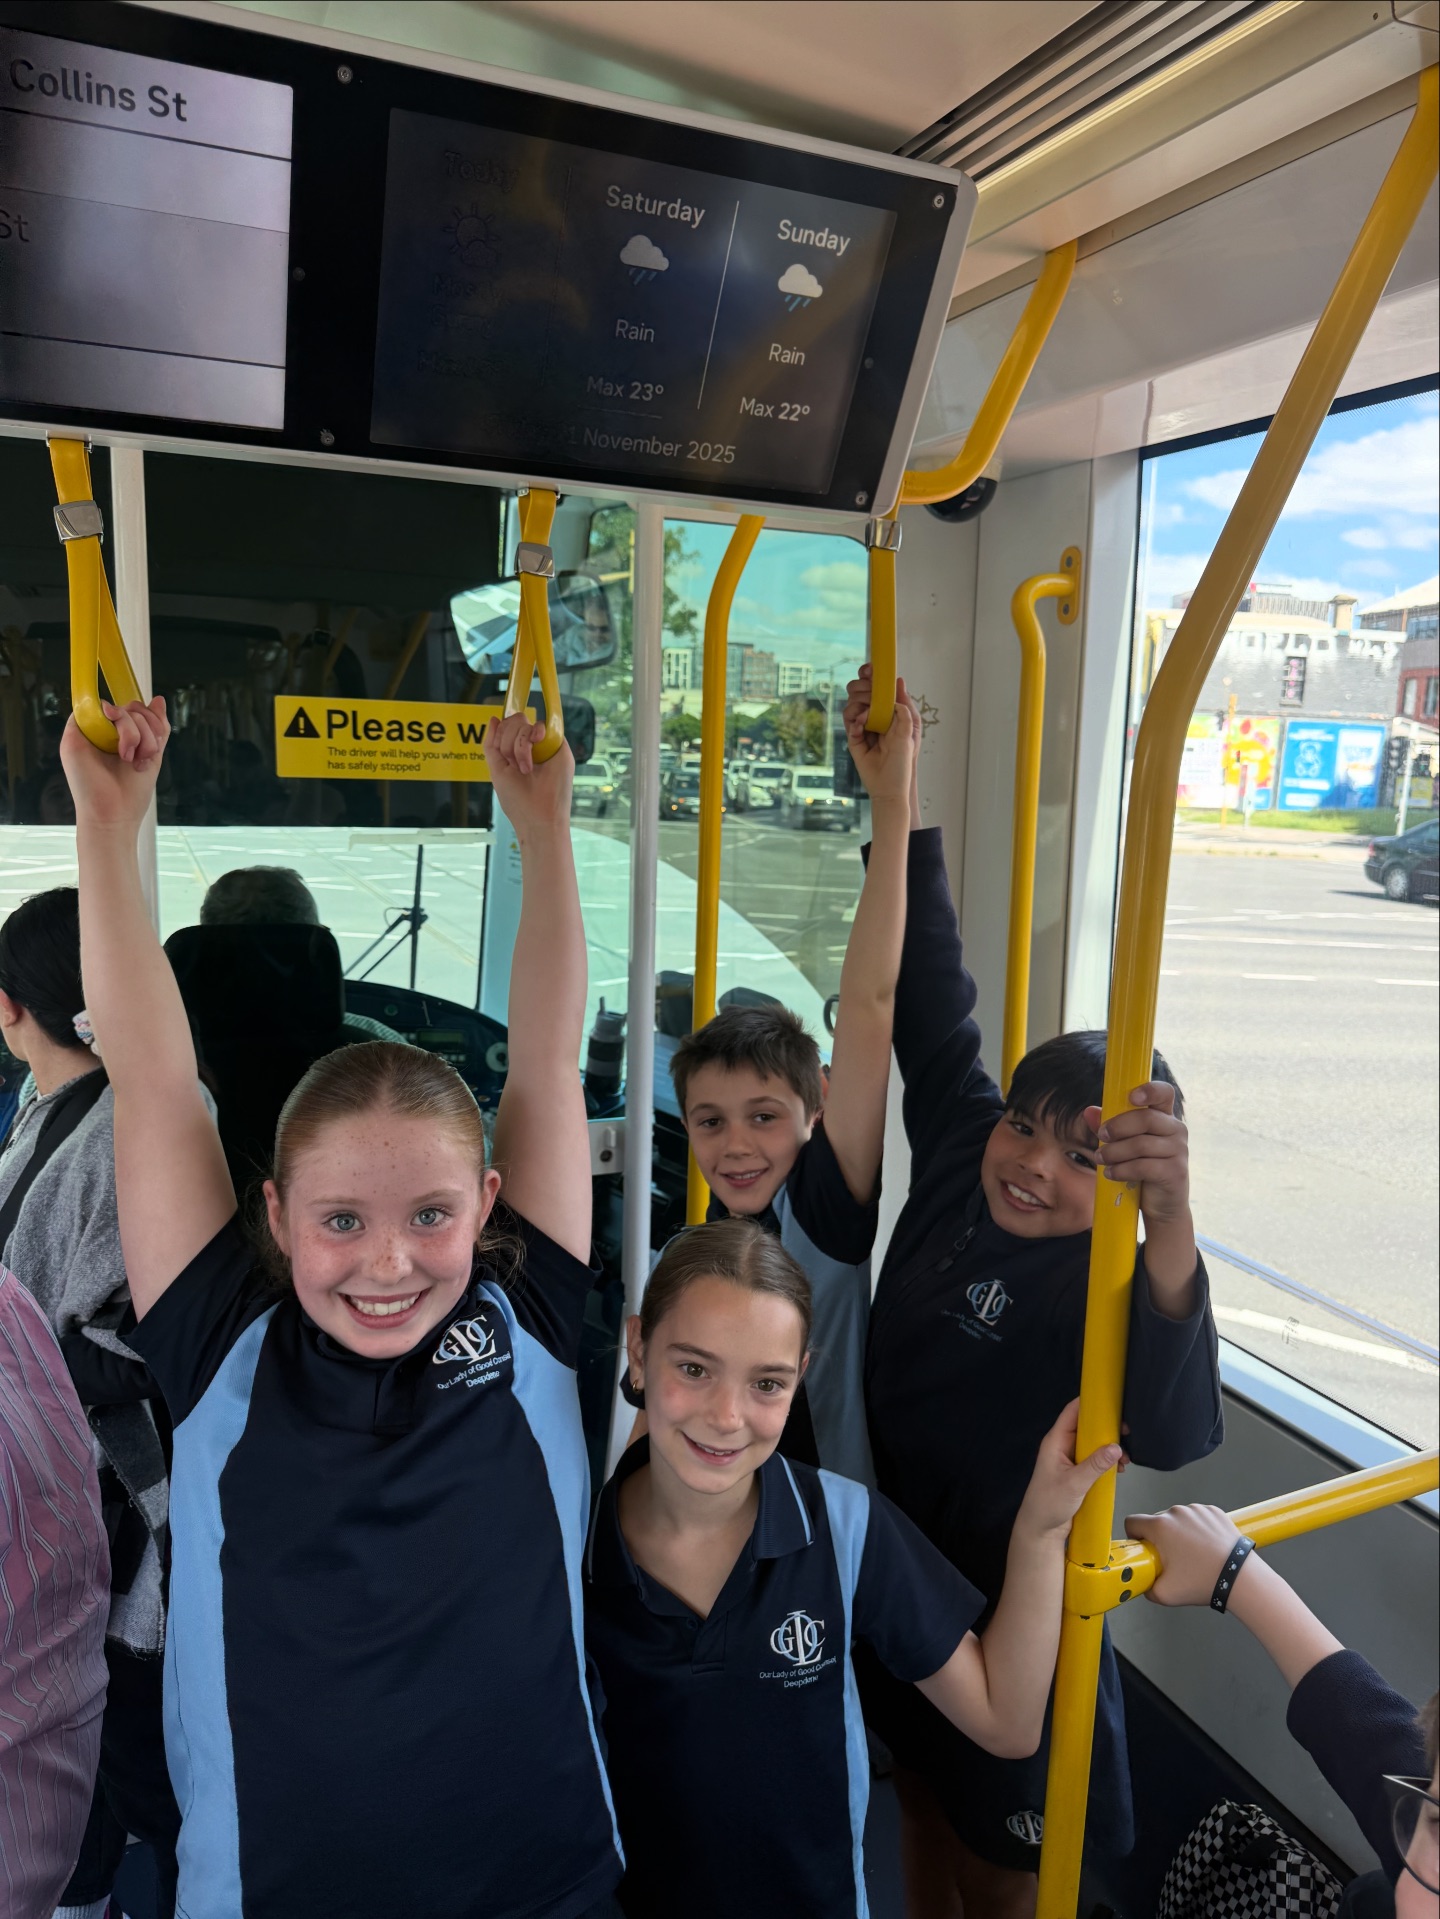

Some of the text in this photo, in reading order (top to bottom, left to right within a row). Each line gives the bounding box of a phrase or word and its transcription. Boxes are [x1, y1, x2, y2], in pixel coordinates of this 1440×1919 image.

[9, 59, 188, 122] Collins St
[605, 185, 706, 229] Saturday
[777, 219, 850, 256] Sunday
[615, 319, 655, 343] Rain
[769, 343, 805, 366] Rain
[587, 375, 625, 398] Max
[739, 397, 774, 418] Max
[583, 427, 682, 457] November
[687, 441, 736, 464] 2025
[326, 709, 446, 743] Please
[327, 746, 485, 761] The driver will help you when the
[327, 760, 421, 773] has safely stopped
[449, 1370, 468, 1385] Lady
[468, 1366, 476, 1375] of
[759, 1671, 772, 1679] Our
[772, 1671, 788, 1679] Lady
[789, 1669, 796, 1677] of
[798, 1666, 815, 1676] Good
